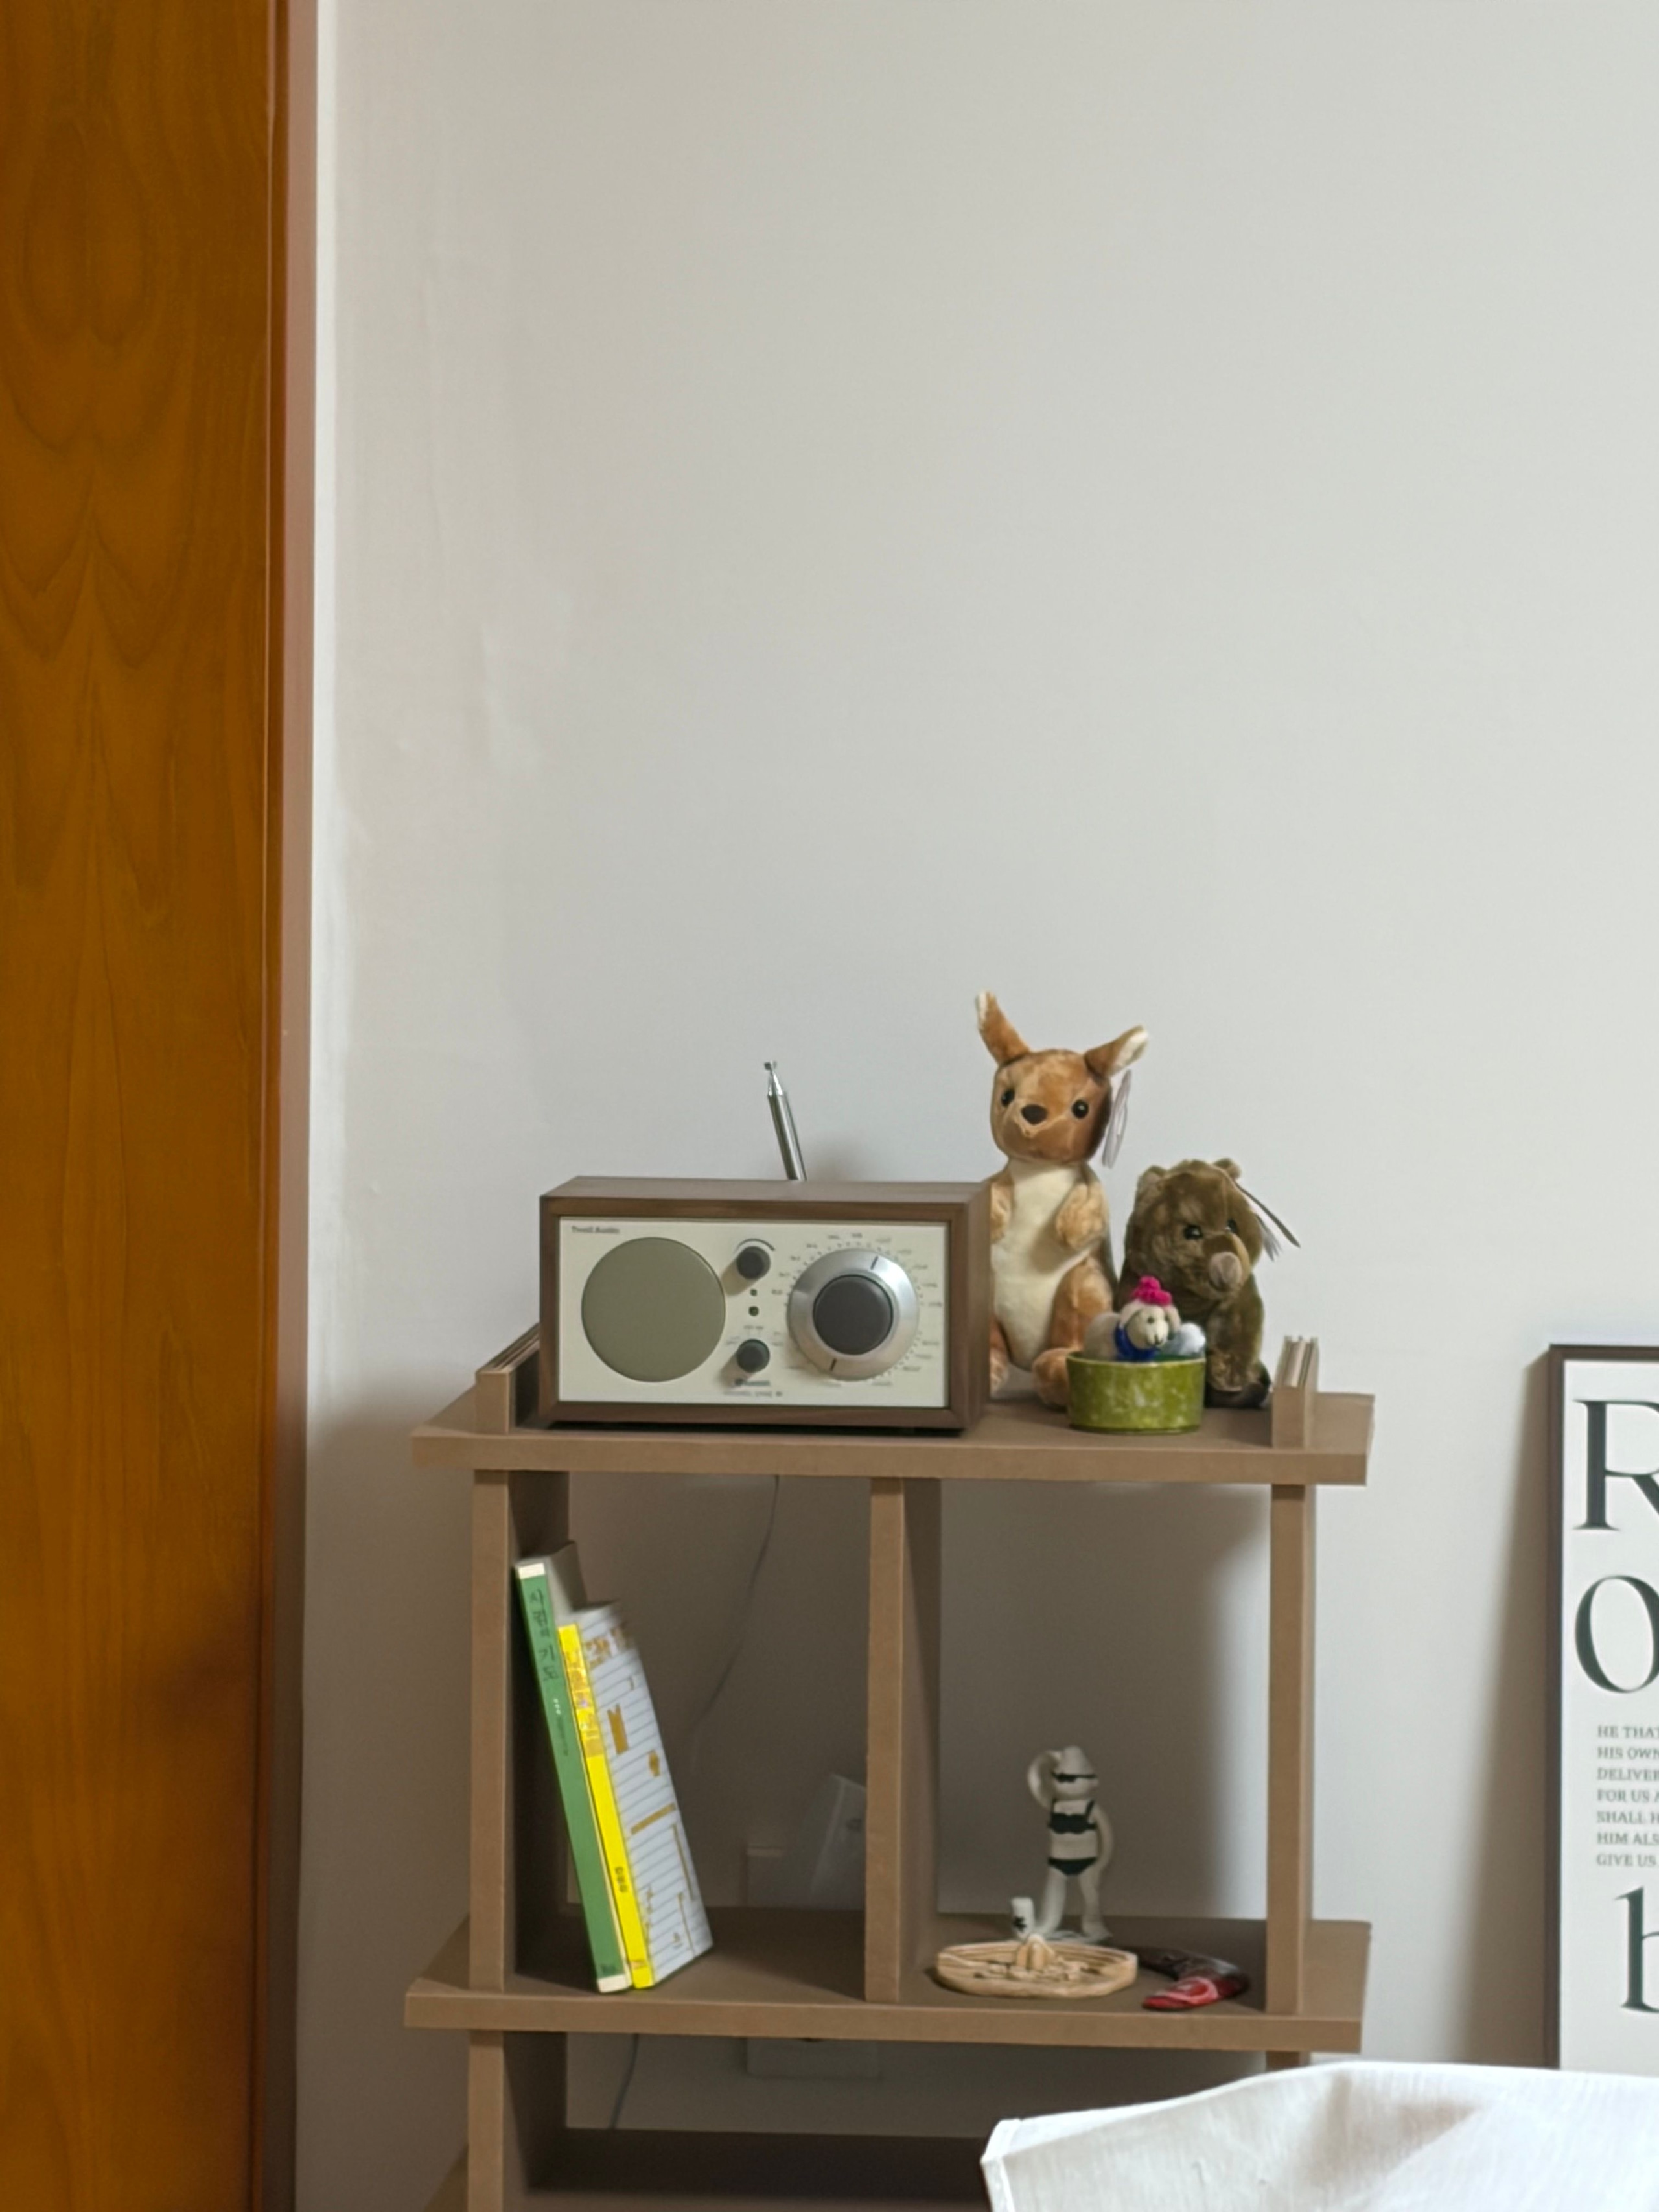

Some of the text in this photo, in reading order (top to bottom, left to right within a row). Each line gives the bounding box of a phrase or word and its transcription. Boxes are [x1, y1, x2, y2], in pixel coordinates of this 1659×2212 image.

[1597, 1725, 1619, 1738] HE
[1597, 1747, 1623, 1759] HIS
[1597, 1789, 1626, 1802] FOR
[1631, 1789, 1649, 1802] US
[1597, 1810, 1643, 1824] SHALL
[1597, 1832, 1629, 1845] HIM
[1597, 1854, 1657, 1867] GIVE US
